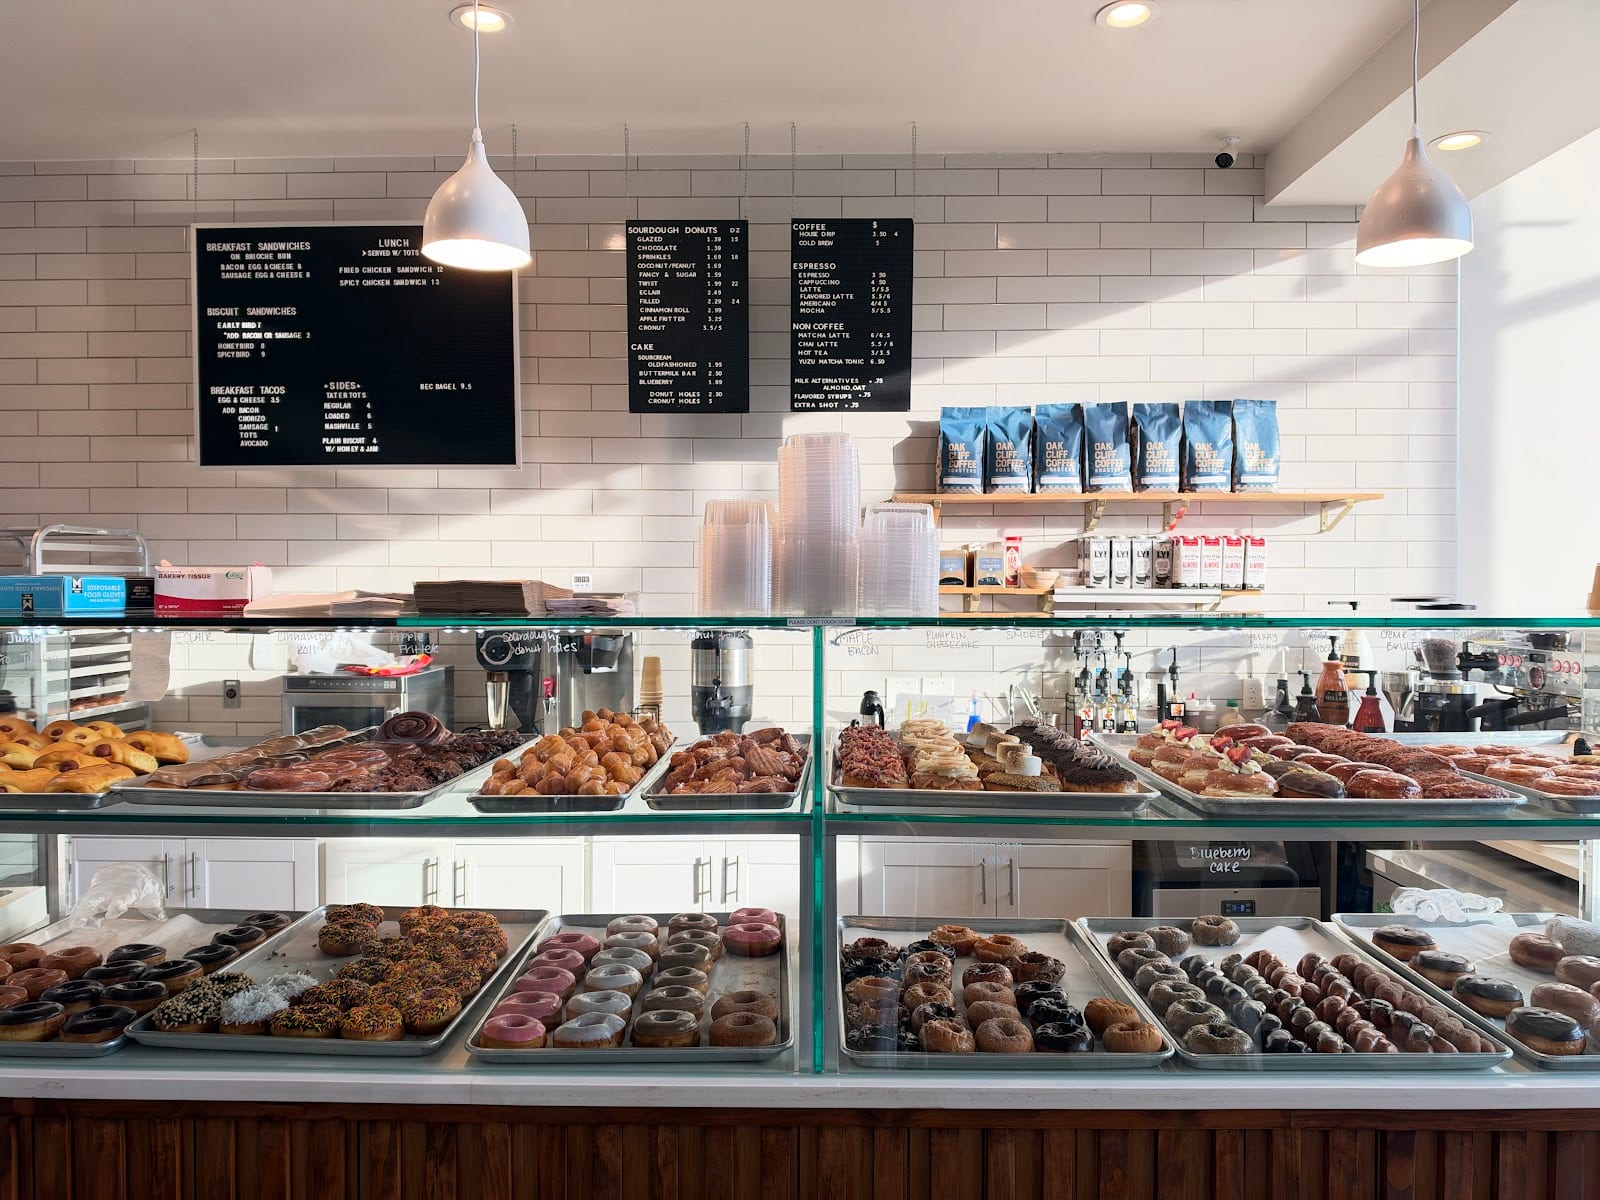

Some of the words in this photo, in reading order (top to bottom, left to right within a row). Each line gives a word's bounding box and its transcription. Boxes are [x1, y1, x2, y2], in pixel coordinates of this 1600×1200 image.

[206, 243, 251, 251] BREAKFAST
[258, 242, 311, 251] SANDWICHES
[379, 239, 409, 247] LUNCH
[207, 308, 239, 316] BISCUIT
[246, 307, 296, 315] SANDWICHES
[210, 386, 254, 395] BREAKFAST
[260, 386, 286, 394] TACOS
[996, 442, 1014, 450] OAK
[1094, 442, 1112, 450] OAK
[1146, 442, 1164, 450] OAK
[1196, 442, 1212, 450] OAK
[948, 452, 970, 460] CLIFF
[996, 450, 1018, 458] CLIFF
[1046, 450, 1068, 458] CLIFF
[1094, 450, 1116, 459] CLIFF
[1146, 450, 1168, 458] CLIFF
[1196, 450, 1218, 459] CLIFF
[948, 460, 976, 468] COFFEE
[996, 459, 1024, 468] COFFEE
[1046, 459, 1075, 467] COFFEE
[1094, 460, 1124, 468] COFFEE
[1146, 459, 1175, 468] COFFEE
[1196, 460, 1224, 468] COFFEE
[848, 646, 880, 656] BACON
